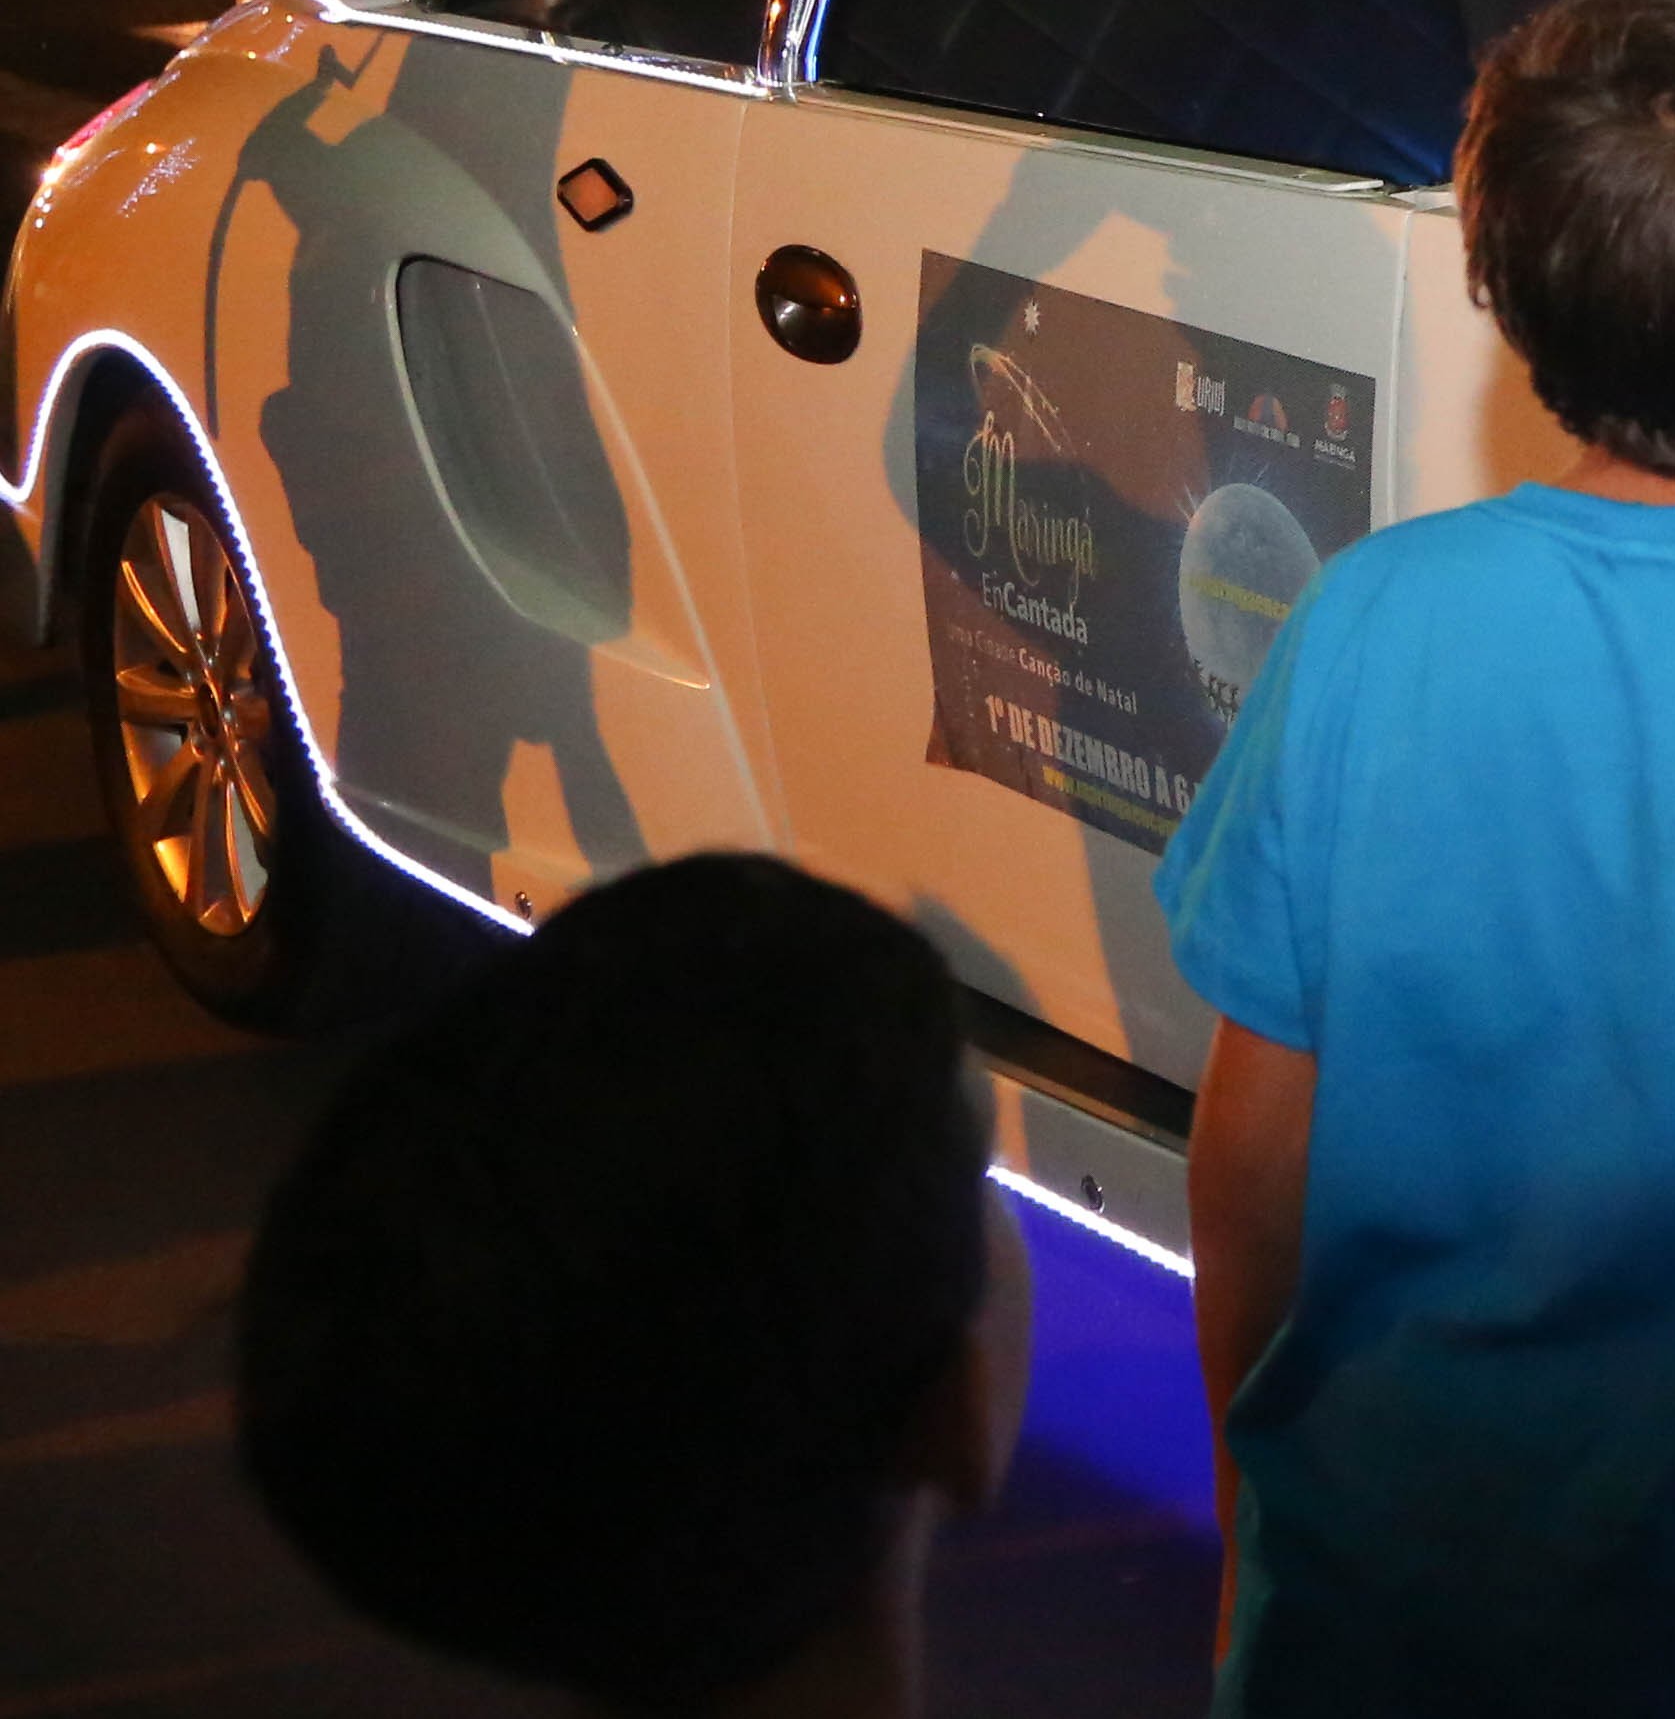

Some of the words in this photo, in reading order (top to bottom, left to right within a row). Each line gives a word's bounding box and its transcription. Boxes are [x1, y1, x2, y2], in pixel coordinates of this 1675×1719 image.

[1019, 647, 1071, 687] Canção
[1075, 670, 1092, 697] de
[1096, 679, 1138, 715] Natal
[1007, 702, 1037, 749] DE
[1038, 713, 1151, 799] DEZEMBRO
